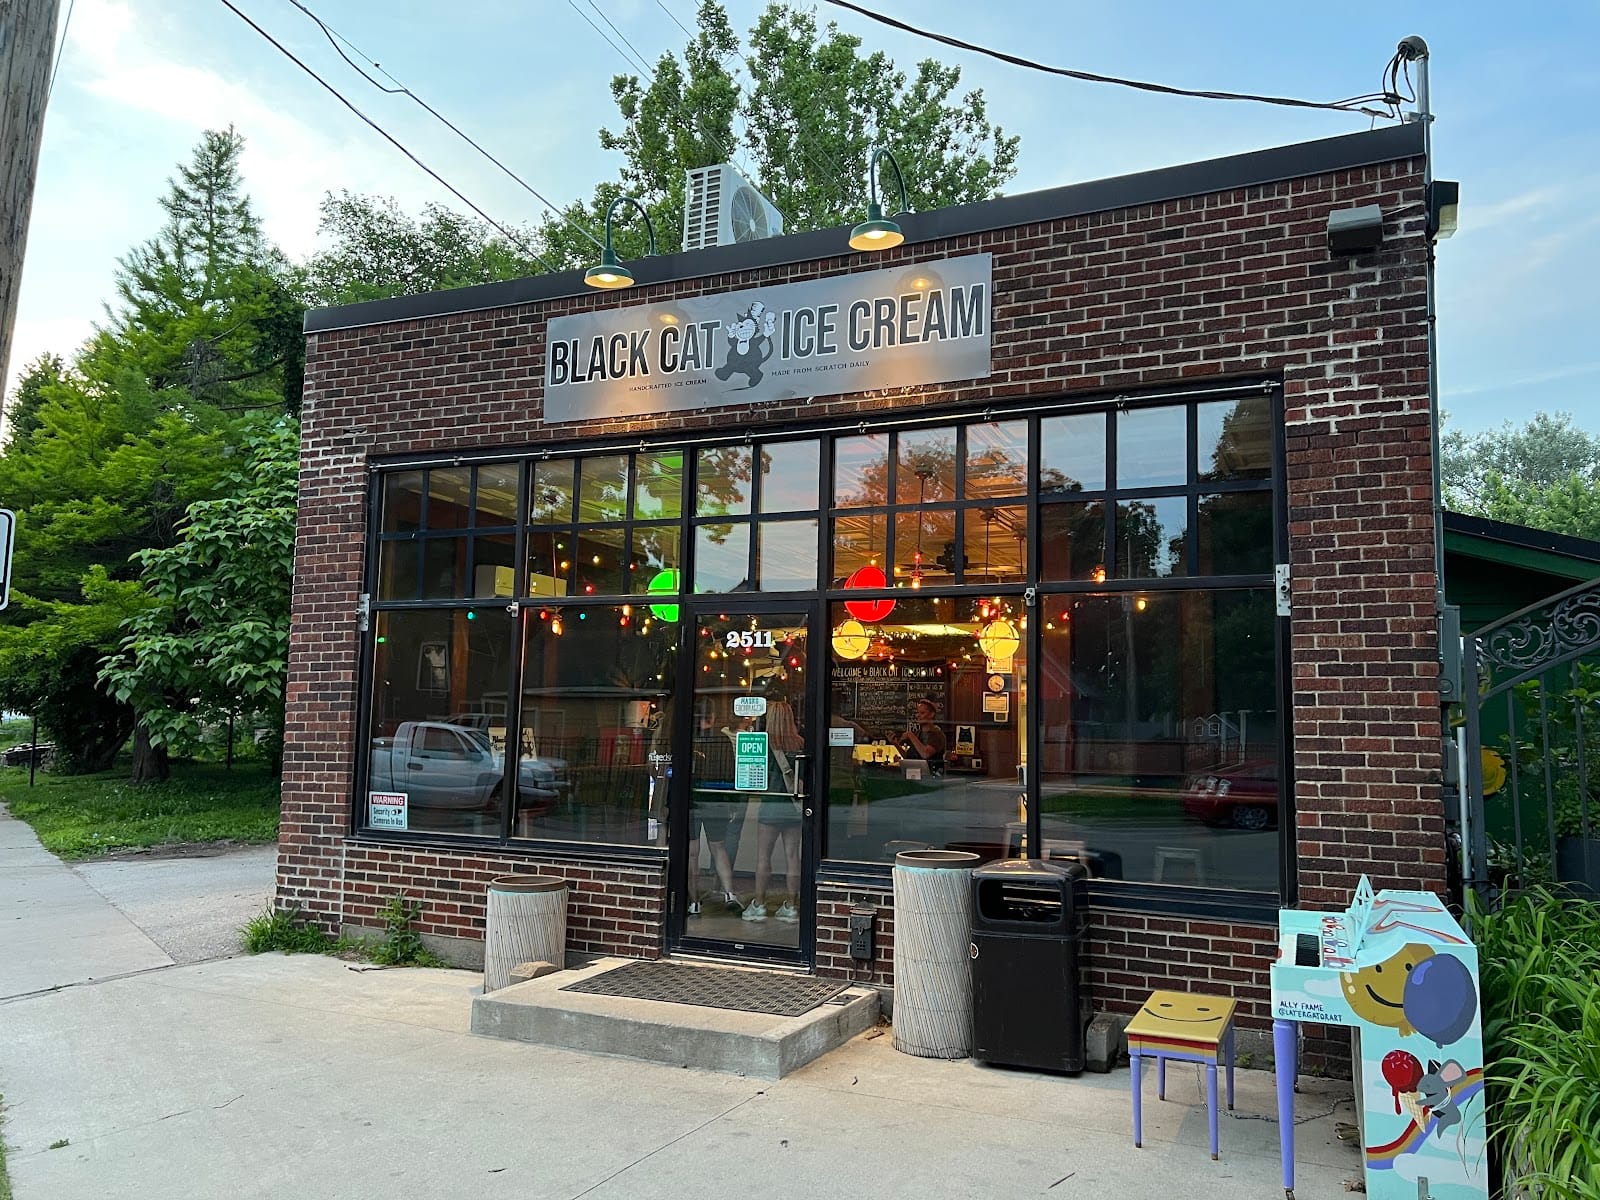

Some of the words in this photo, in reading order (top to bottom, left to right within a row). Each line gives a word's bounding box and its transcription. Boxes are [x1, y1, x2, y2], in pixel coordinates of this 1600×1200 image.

[549, 329, 651, 387] BLACK
[658, 319, 722, 375] CAT
[780, 304, 839, 361] ICE
[848, 283, 986, 353] CREAM
[793, 367, 812, 375] FROM
[815, 363, 847, 372] SCRATCH
[849, 360, 870, 368] DAILY
[629, 382, 672, 392] HANDCRAFTED
[685, 378, 707, 386] CREAM
[726, 631, 772, 648] 2511
[831, 667, 862, 677] WELCOME
[869, 666, 887, 677] BLACK
[741, 742, 763, 753] OPEN
[372, 795, 404, 806] WARNING
[373, 807, 390, 817] Security
[373, 816, 390, 825] Cameras
[1280, 1001, 1298, 1009] ALLY
[1301, 1002, 1324, 1012] FRAME
